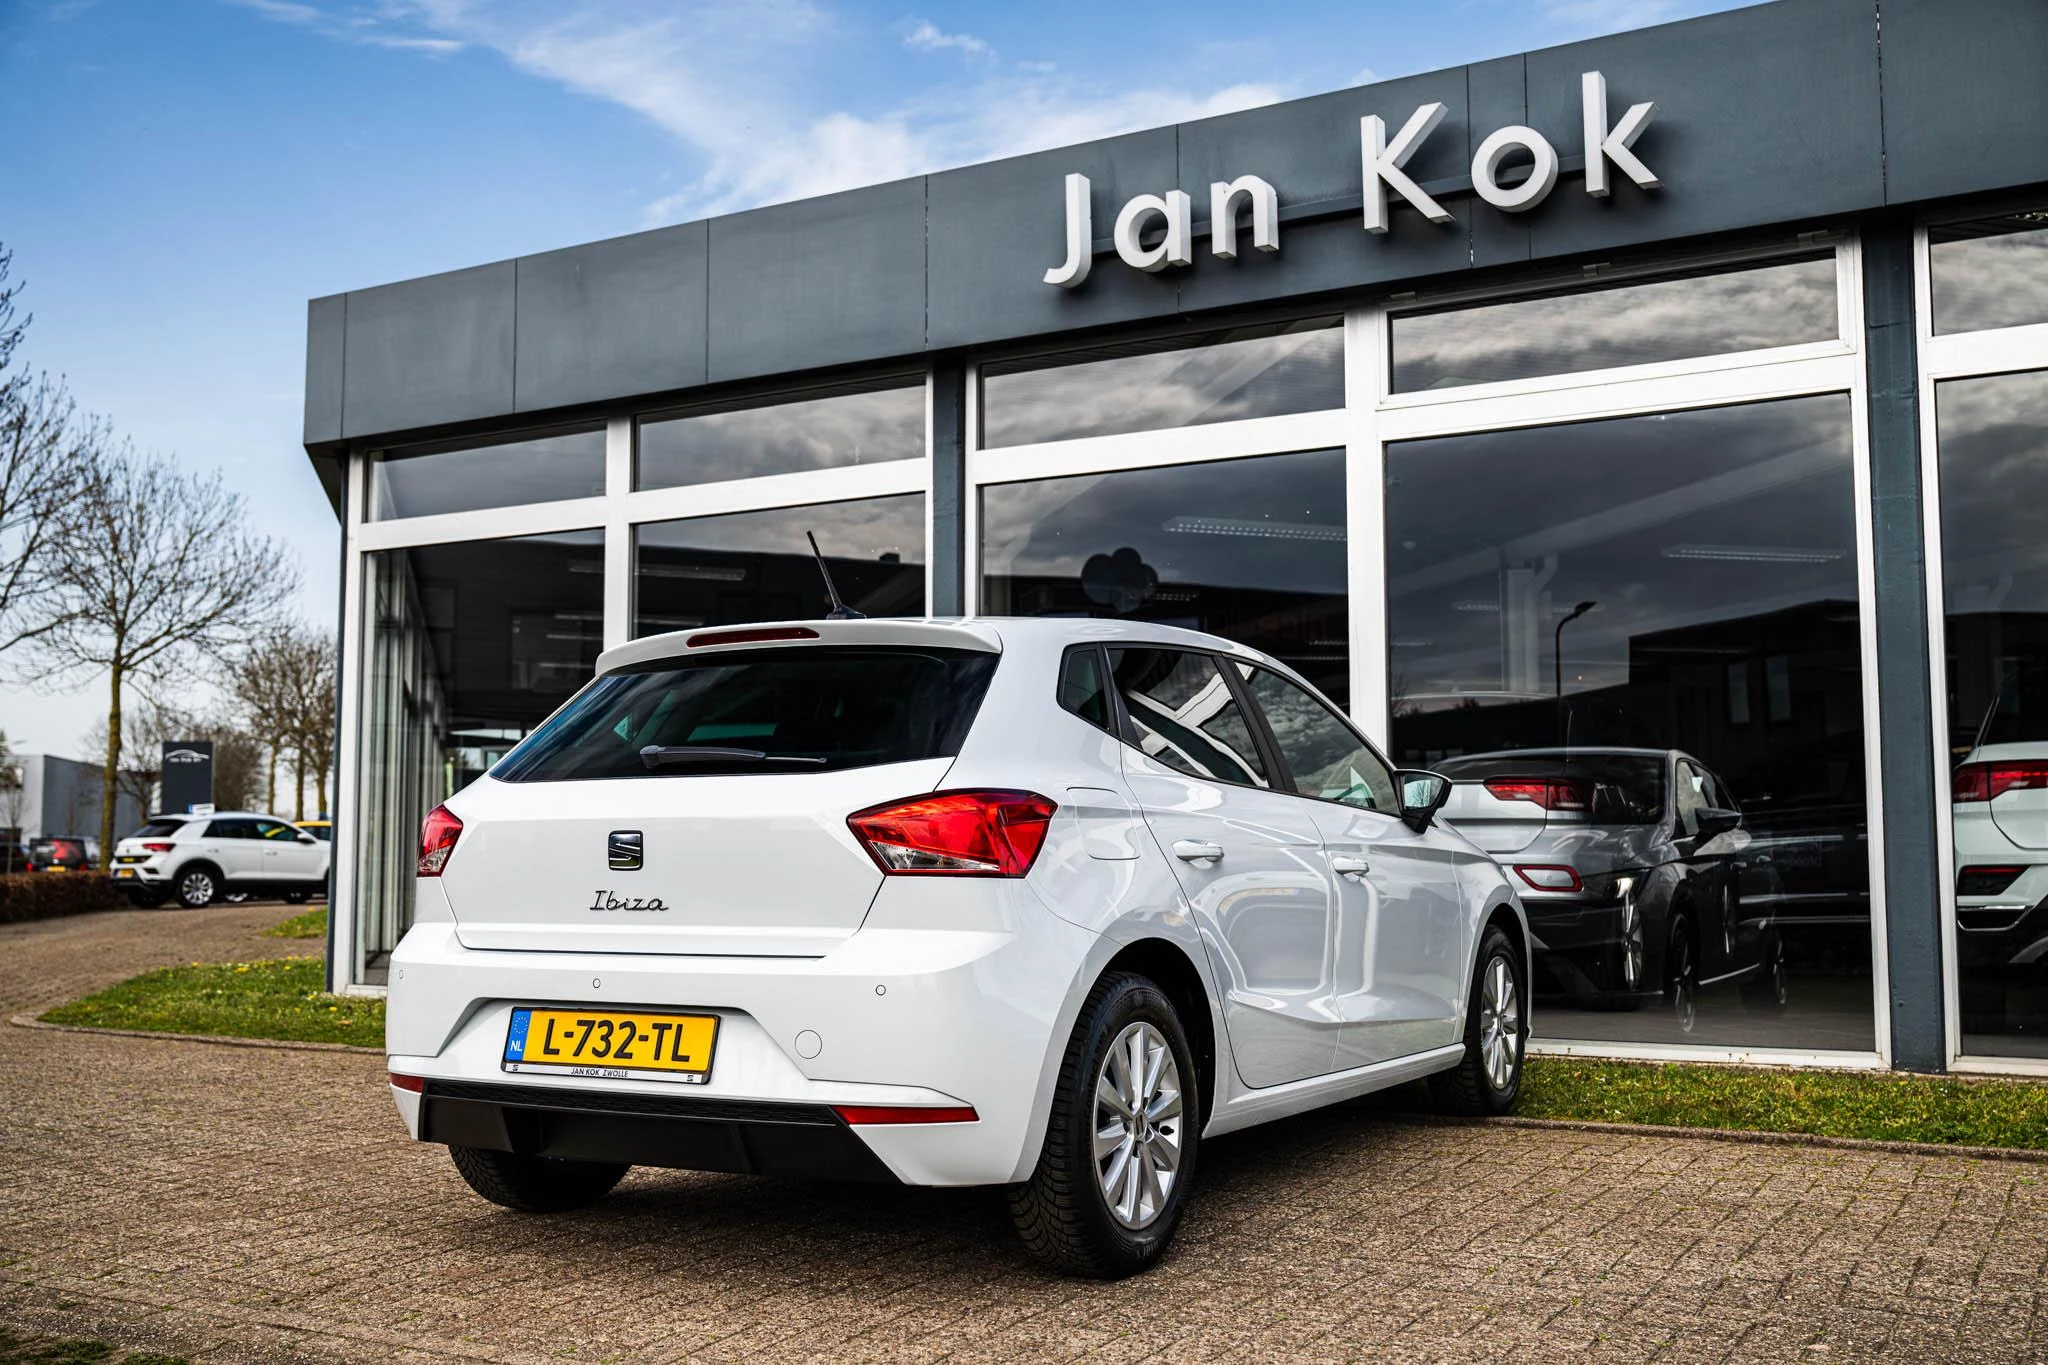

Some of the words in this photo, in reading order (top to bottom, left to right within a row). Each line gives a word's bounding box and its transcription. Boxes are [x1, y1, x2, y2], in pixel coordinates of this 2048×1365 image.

[1042, 172, 1280, 288] Jan
[1359, 70, 1665, 234] Kok
[589, 889, 670, 912] Ibiza
[509, 1040, 523, 1052] NL
[543, 1018, 690, 1062] L-732-TL
[571, 1067, 585, 1076] JAN
[585, 1068, 600, 1077] KOK
[602, 1069, 629, 1079] ZWOLLE
